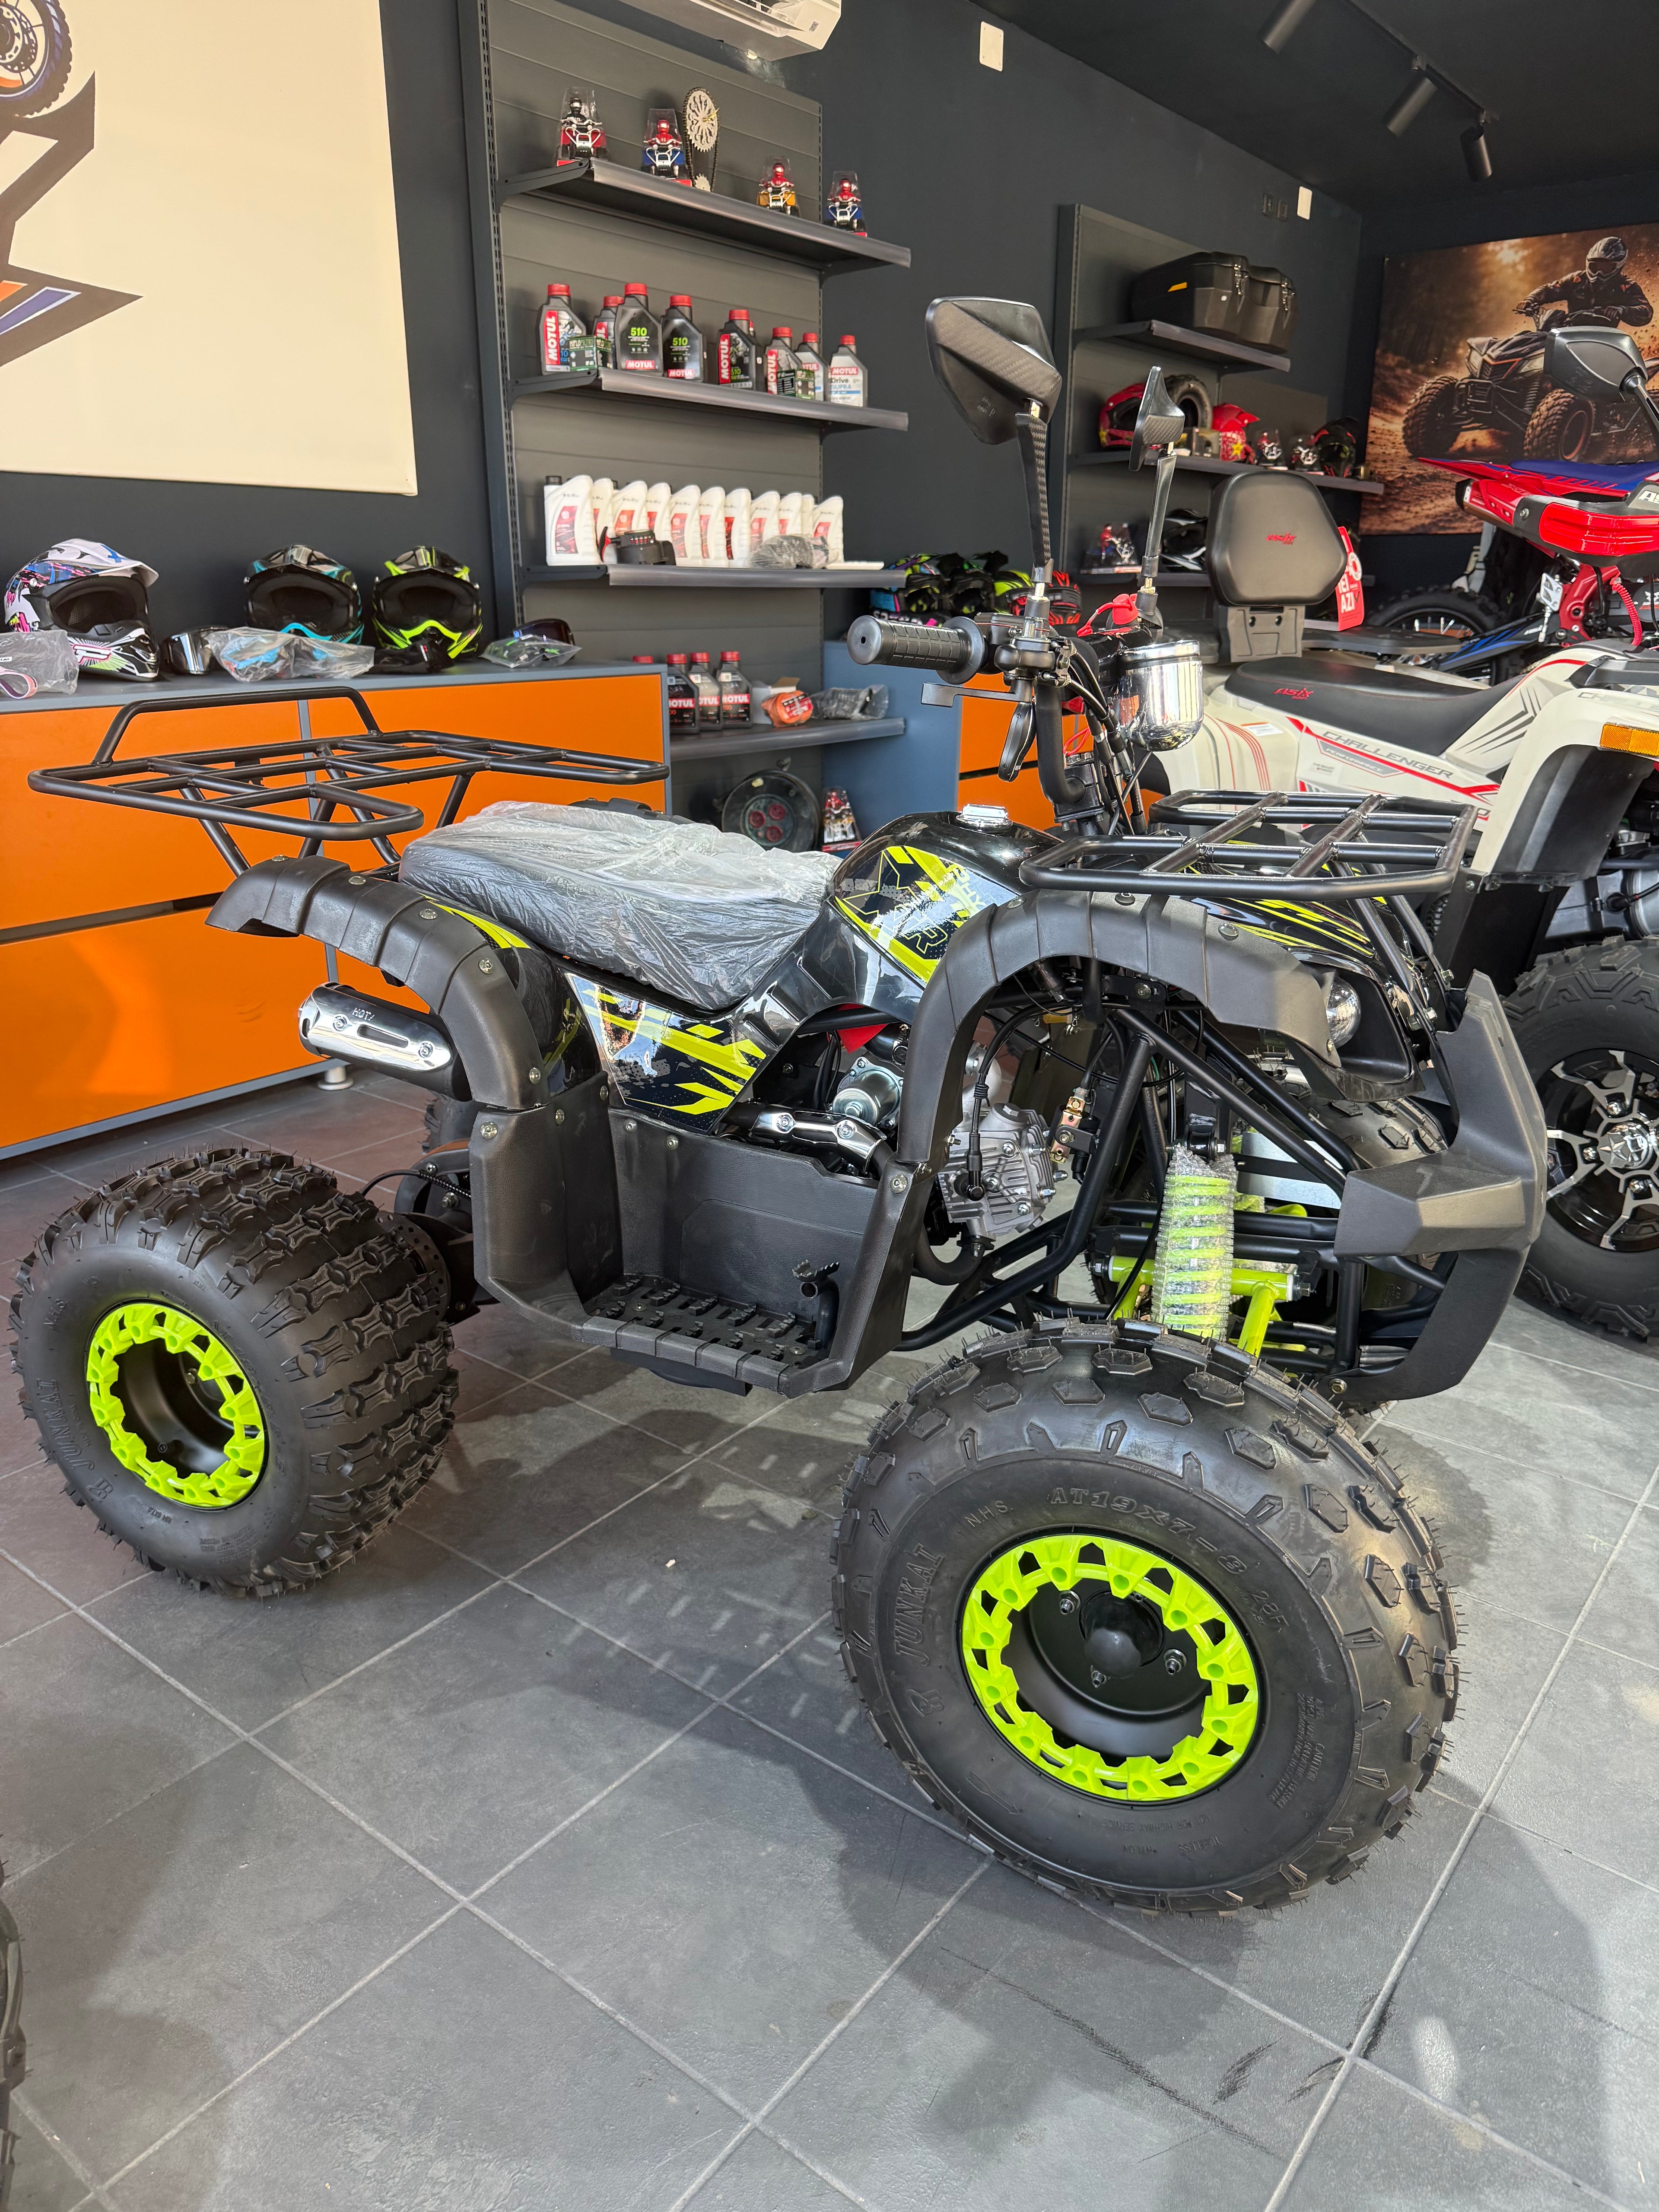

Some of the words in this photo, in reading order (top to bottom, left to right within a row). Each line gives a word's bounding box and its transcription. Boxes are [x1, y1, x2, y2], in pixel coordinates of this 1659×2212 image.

[546, 316, 558, 361] MOTUL
[630, 327, 647, 336] 510
[672, 337, 688, 346] 510
[721, 339, 729, 379] MOTUL
[669, 370, 695, 378] MOTUL
[769, 353, 777, 393] MOTUL
[1341, 591, 1355, 613] AZI
[1322, 731, 1453, 779] CHALLENGER
[1325, 748, 1384, 773] PERFORMANCE
[352, 1007, 375, 1021] HOT!
[36, 1379, 95, 1470] JUNKAI
[894, 1543, 944, 1667] JUNKAI
[1306, 1742, 1325, 1782] CAUTION
[1102, 1818, 1135, 1831] SERVICE
[1140, 1823, 1173, 1832] HIGHWAY
[1178, 1819, 1192, 1830] FOR
